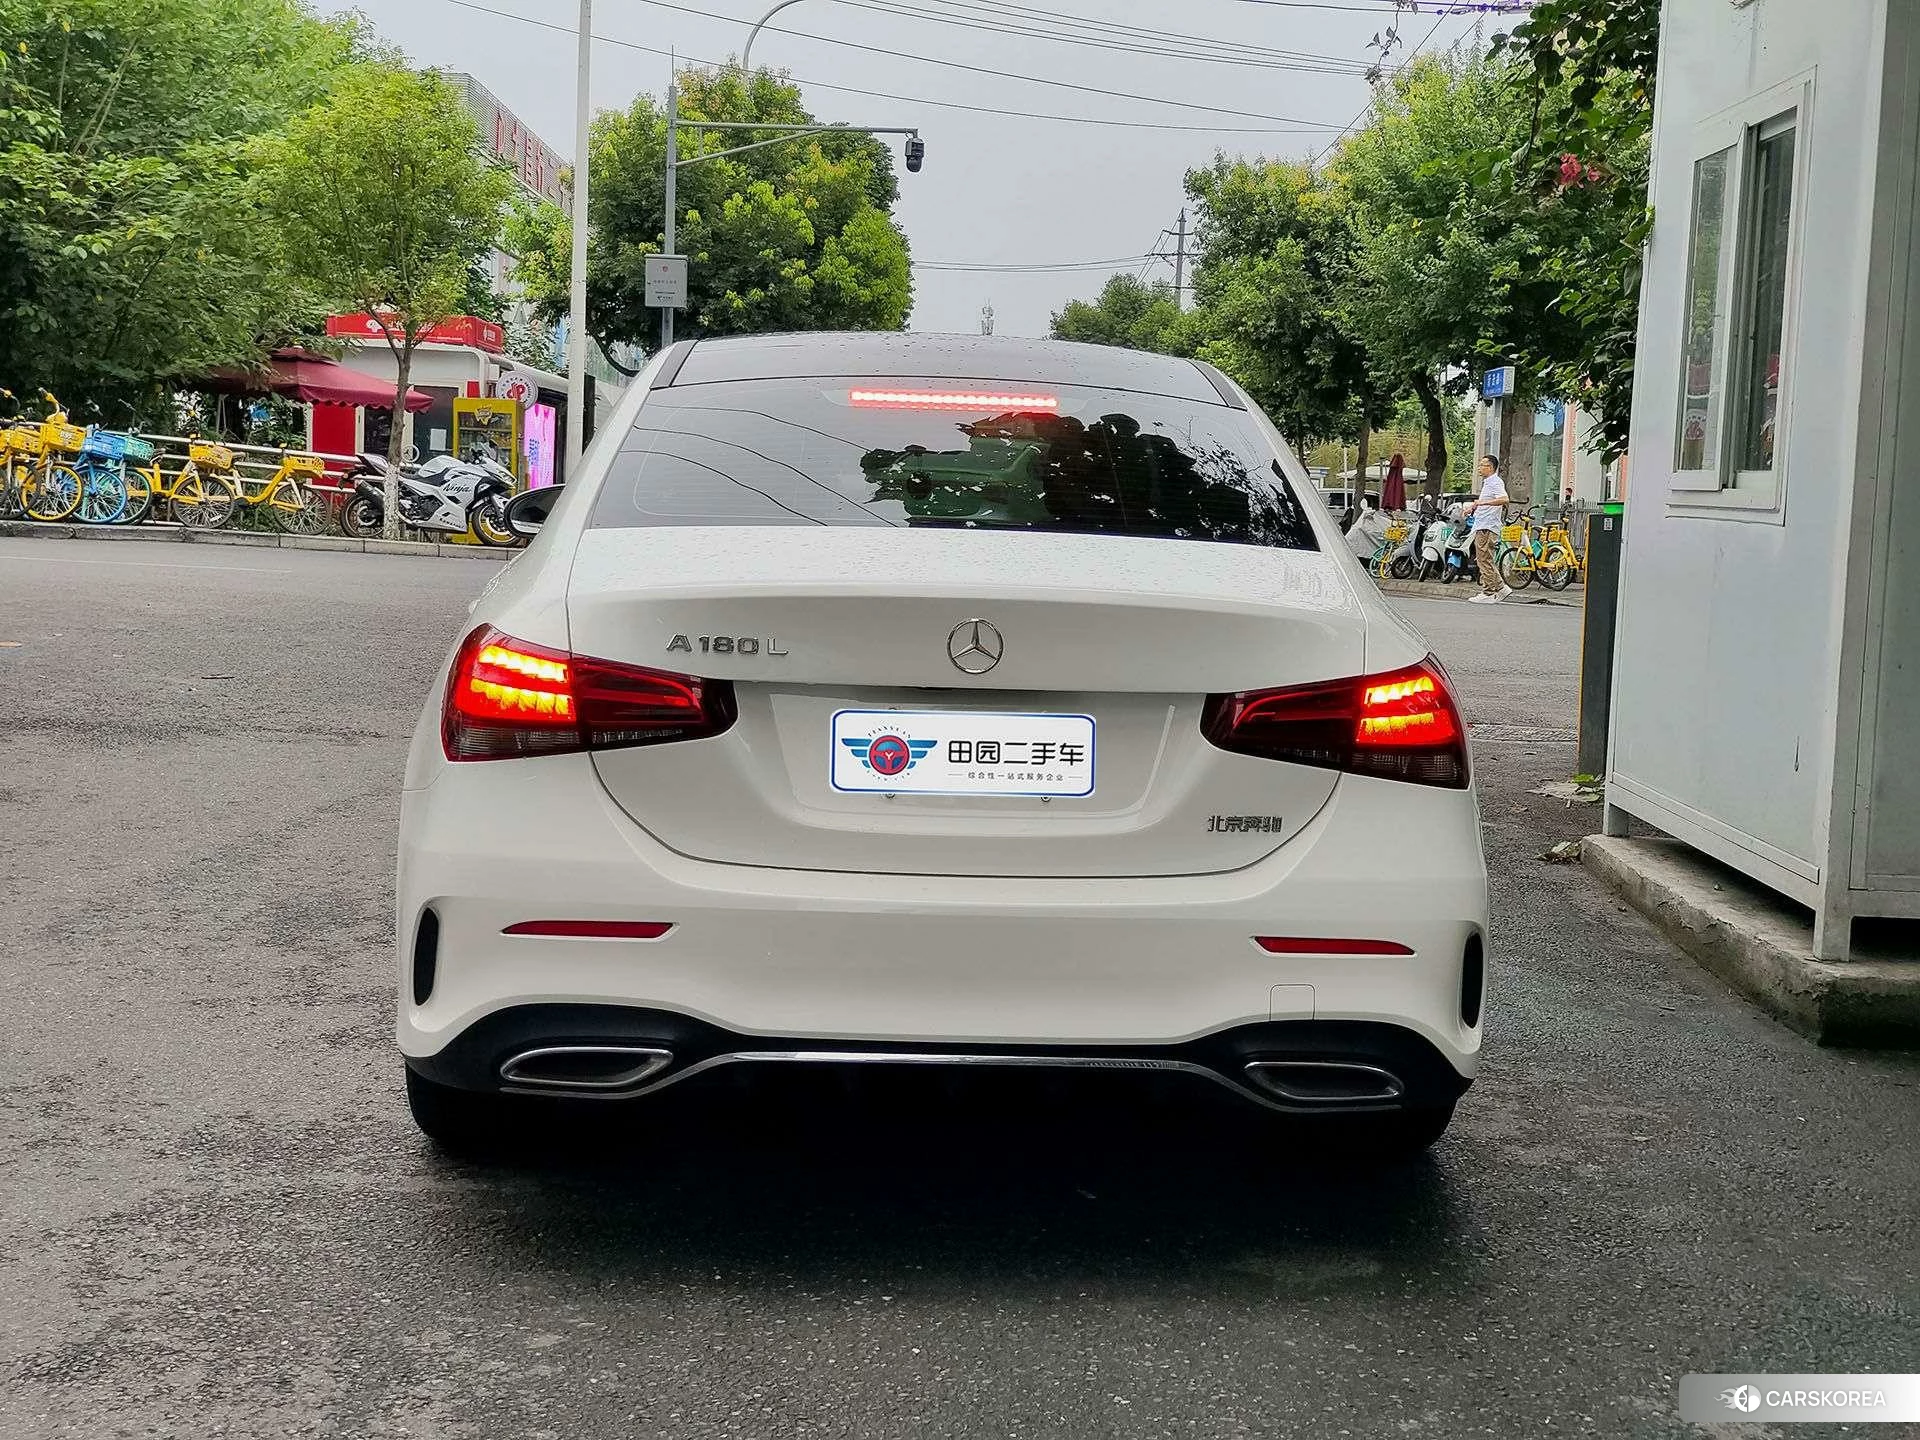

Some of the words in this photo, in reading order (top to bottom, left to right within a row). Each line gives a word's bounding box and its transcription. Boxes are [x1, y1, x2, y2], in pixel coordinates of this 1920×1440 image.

[948, 740, 1085, 766] 田园二手车
[967, 771, 1064, 782] 综合性一站式服务企业
[1207, 815, 1283, 832] 北京奔驰
